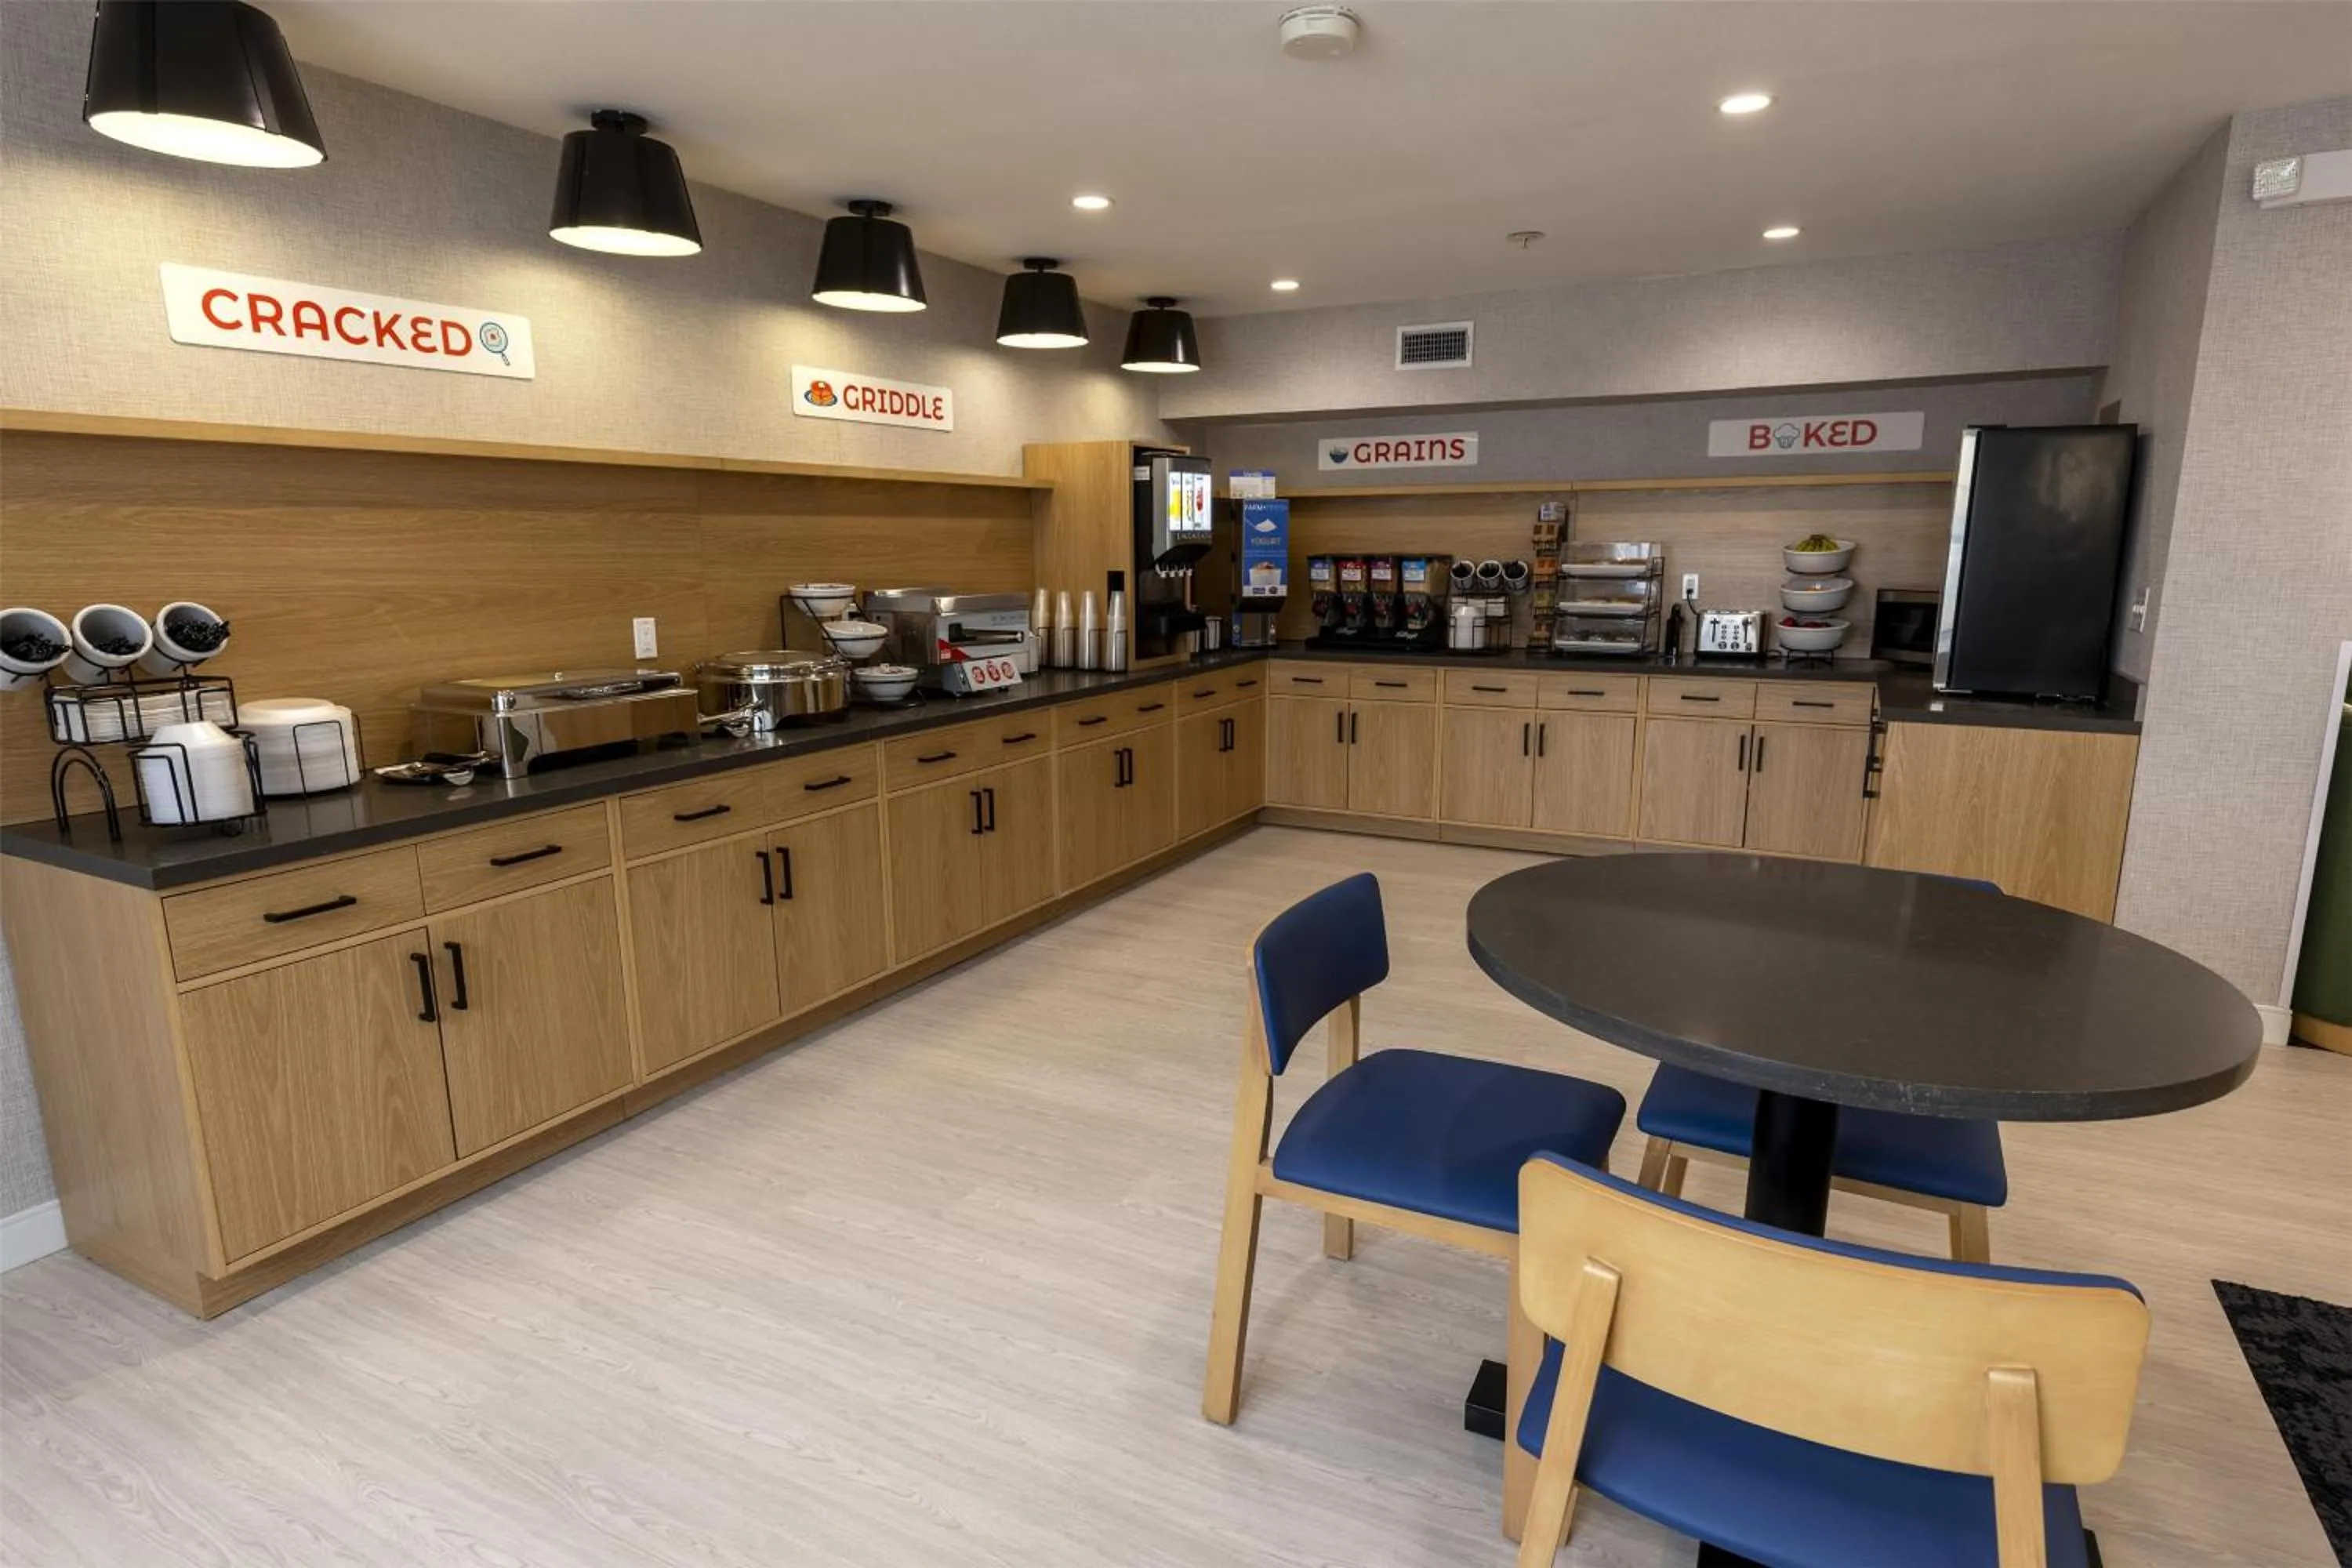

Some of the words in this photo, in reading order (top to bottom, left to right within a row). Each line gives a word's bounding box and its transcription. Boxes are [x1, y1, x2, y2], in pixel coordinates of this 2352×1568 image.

[201, 289, 473, 357] CRACKED
[843, 384, 945, 420] GRIDDLE
[1354, 438, 1465, 463] GRAINS
